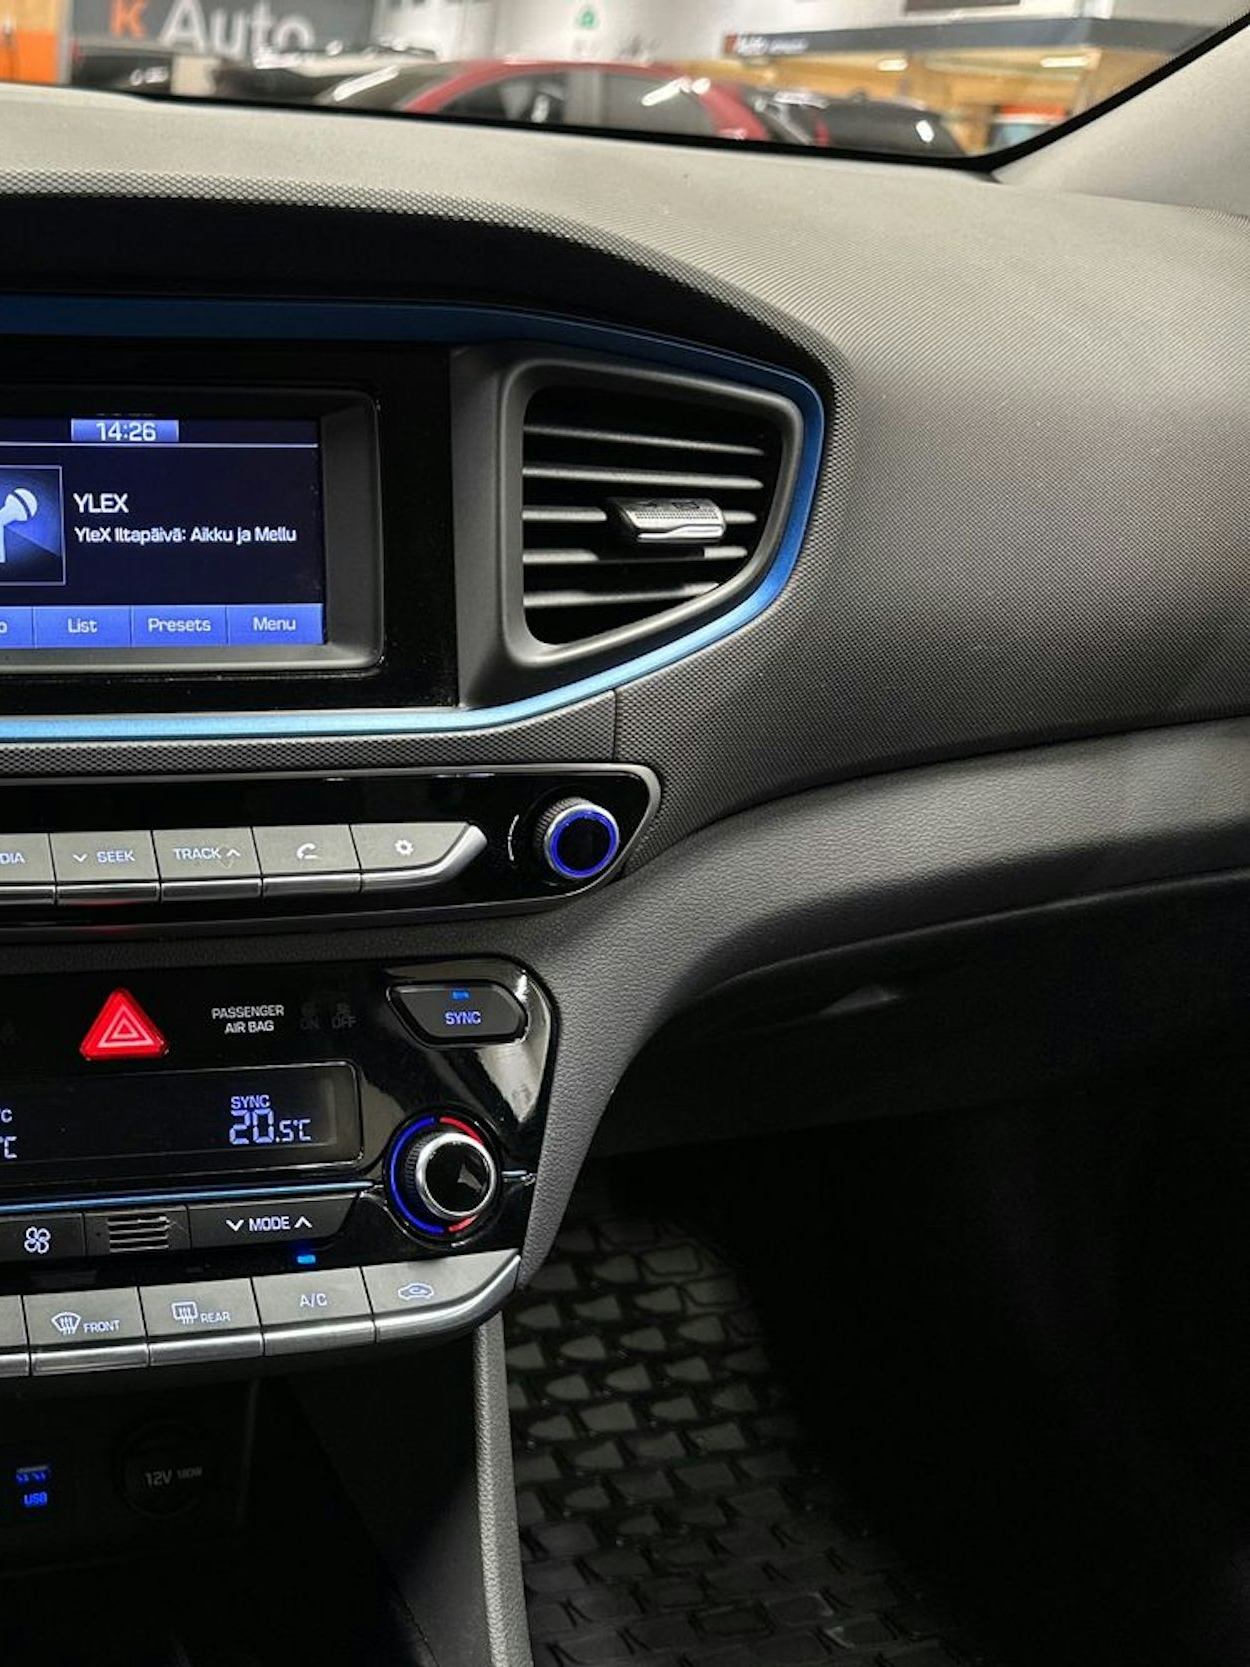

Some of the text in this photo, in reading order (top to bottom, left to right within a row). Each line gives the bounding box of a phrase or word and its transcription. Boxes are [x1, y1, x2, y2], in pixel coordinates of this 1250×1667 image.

[158, 0, 316, 57] Auto
[95, 421, 157, 441] 14:26
[73, 493, 129, 514] YLEX
[74, 526, 111, 544] YleX
[190, 525, 234, 543] Aikku
[236, 526, 252, 545] ja
[254, 525, 297, 542] Mellu
[68, 618, 97, 634] List
[148, 617, 211, 634] Presets
[253, 615, 296, 632] Menu
[97, 849, 136, 863] SEEK
[173, 847, 221, 860] TRACK
[212, 1005, 284, 1019] PASSENGER
[444, 1010, 482, 1026] SYNC
[225, 1020, 275, 1034] AIR BAG
[230, 1095, 270, 1109] SYNC
[249, 1216, 291, 1231] MODE
[299, 1293, 328, 1308] A/C
[200, 1311, 231, 1323] REAR
[83, 1319, 121, 1333] FRONT
[145, 1469, 172, 1486] 12V
[23, 1492, 48, 1507] USB
